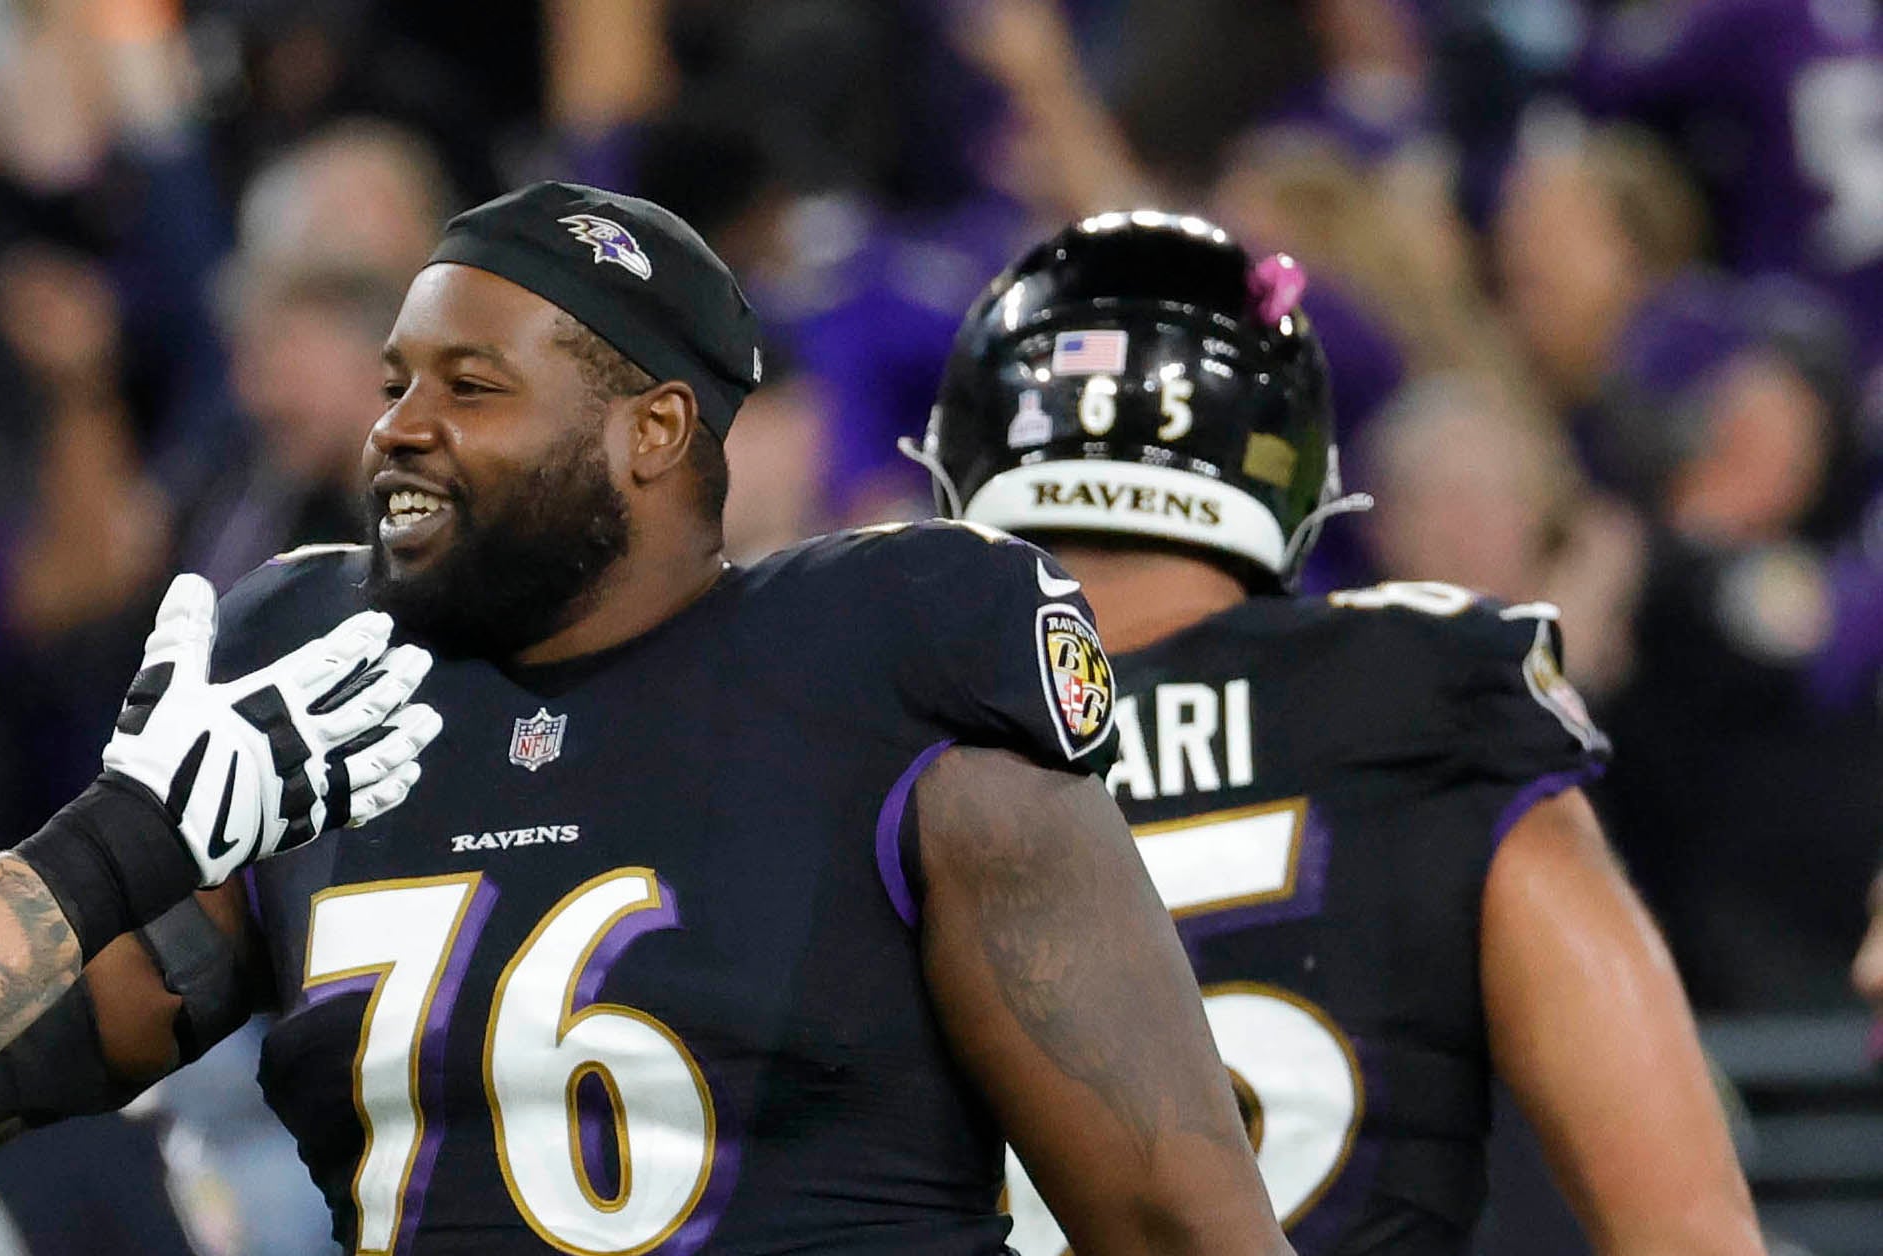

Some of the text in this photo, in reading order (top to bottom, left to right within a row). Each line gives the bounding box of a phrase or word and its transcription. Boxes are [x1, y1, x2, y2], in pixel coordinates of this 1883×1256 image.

[1031, 481, 1221, 526] RAVENS
[518, 733, 556, 758] NFL
[1105, 677, 1255, 801] ARI
[451, 824, 580, 852] RAVENS
